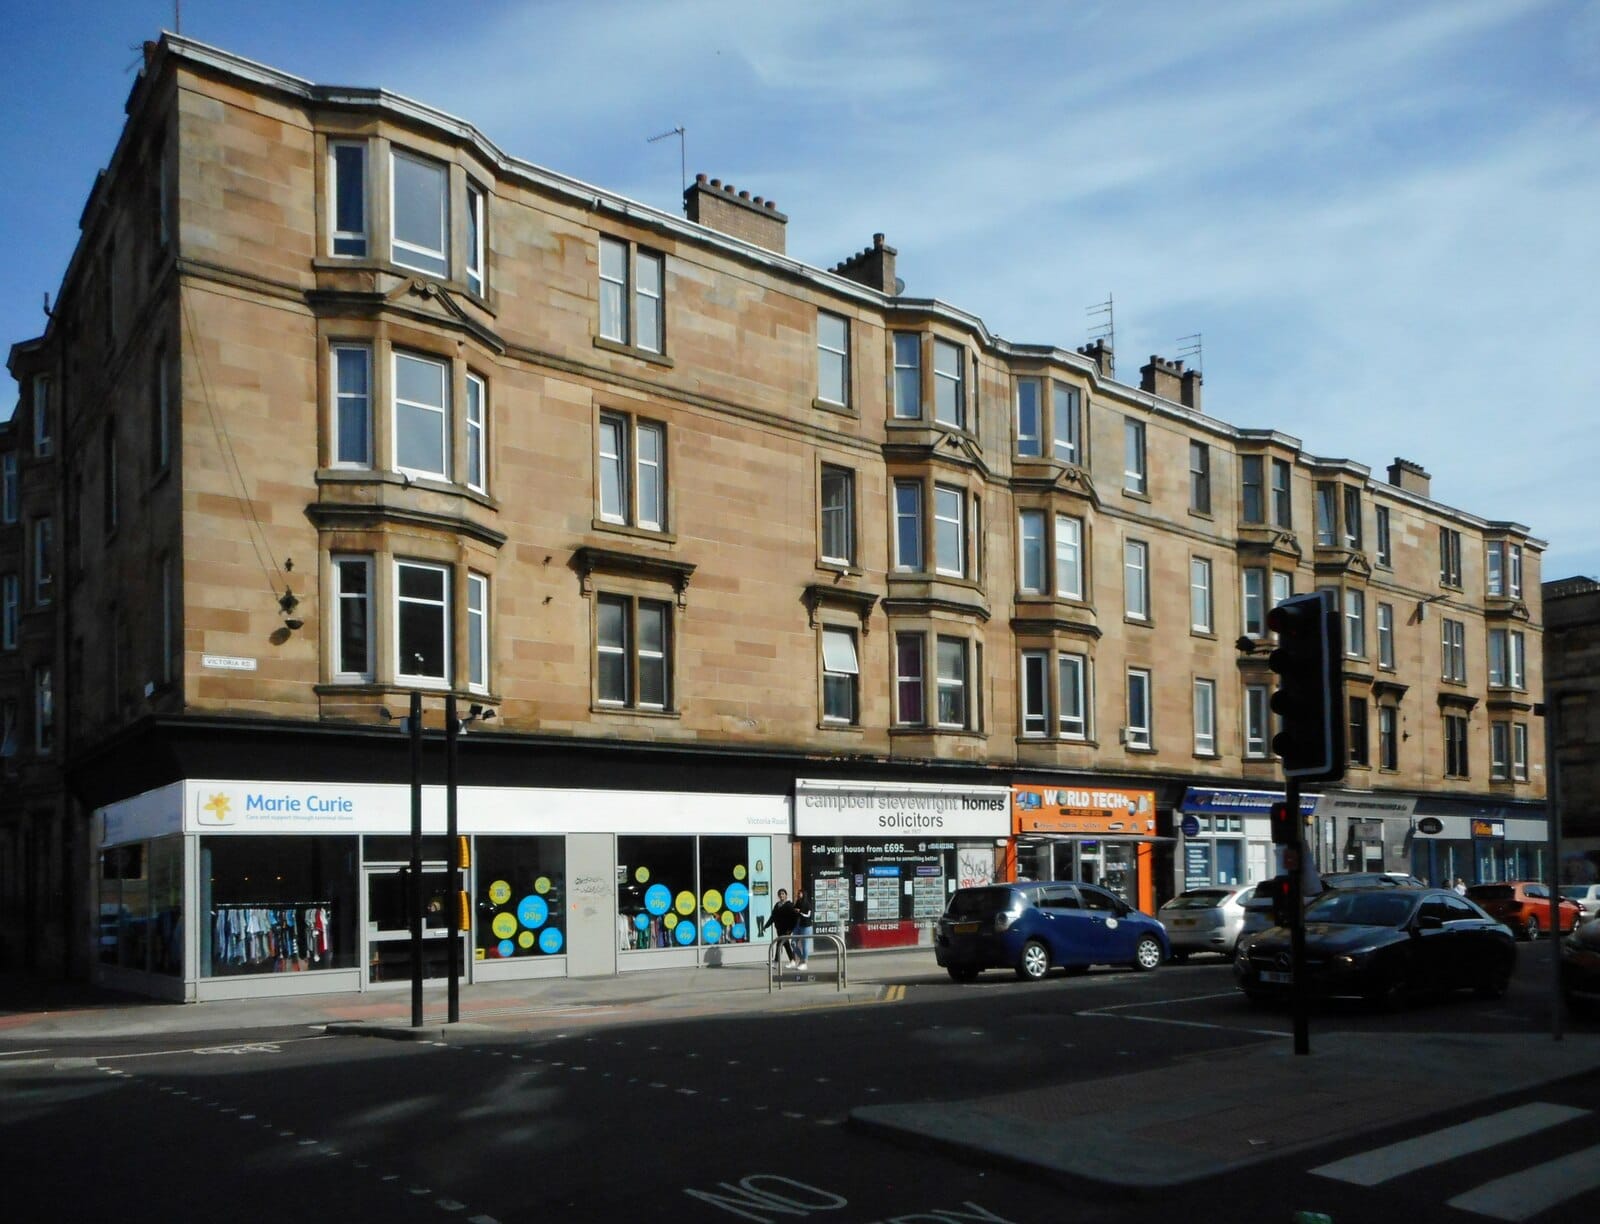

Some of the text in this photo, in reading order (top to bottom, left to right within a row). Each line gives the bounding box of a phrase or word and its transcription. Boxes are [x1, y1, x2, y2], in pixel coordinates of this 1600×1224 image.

[246, 793, 353, 812] Marie Curie
[805, 792, 874, 812] campbell
[961, 795, 1005, 811] homes
[746, 816, 787, 825] Victoria Road
[879, 812, 944, 828] solicitors
[812, 845, 825, 853] Sell
[826, 846, 843, 855] your
[844, 845, 865, 853] house
[866, 845, 883, 853] from
[524, 911, 542, 923] 99p
